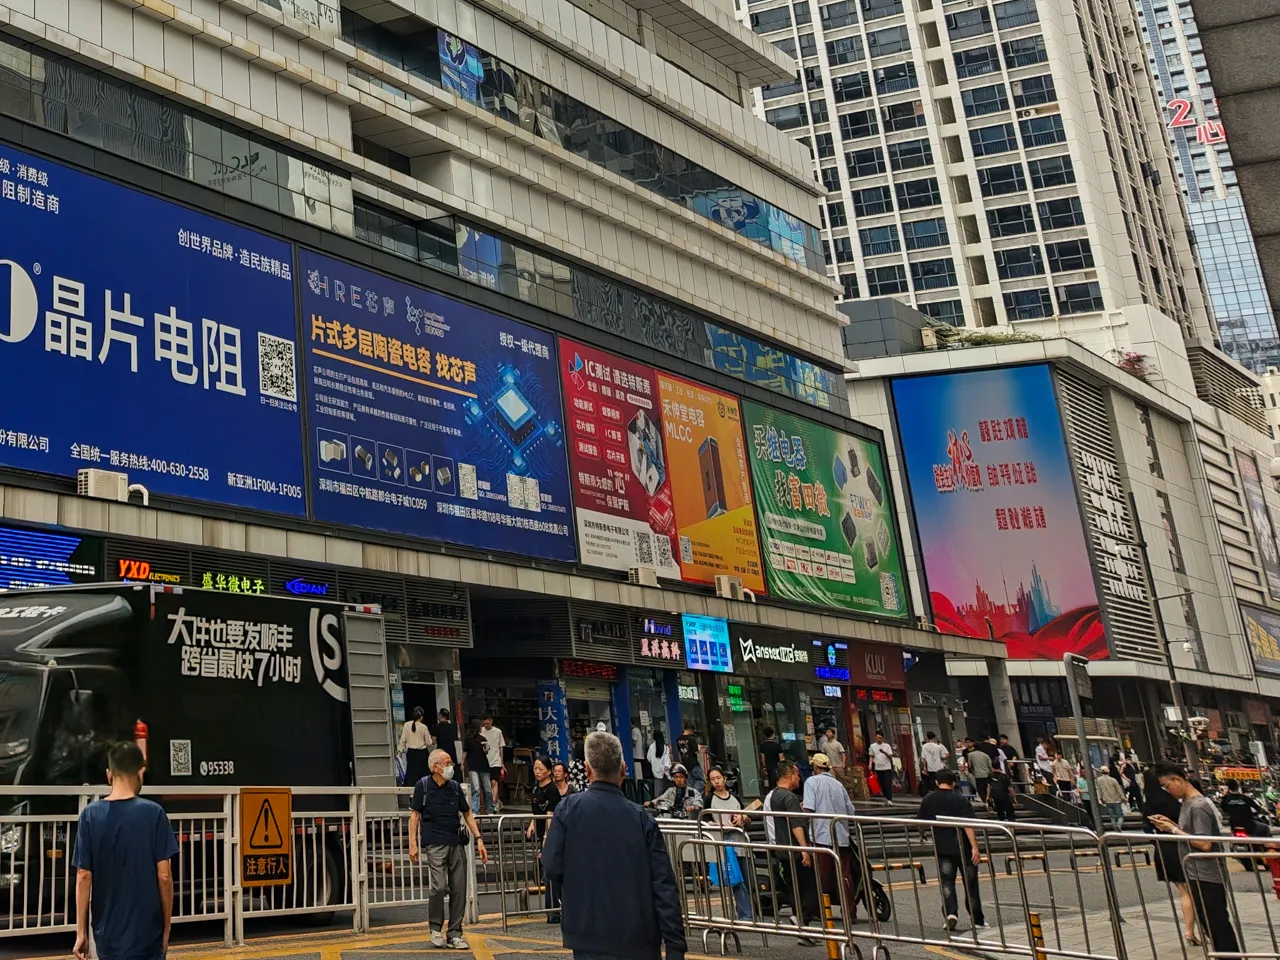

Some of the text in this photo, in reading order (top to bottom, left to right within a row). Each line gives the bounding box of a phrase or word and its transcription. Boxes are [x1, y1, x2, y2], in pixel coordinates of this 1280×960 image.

[44, 275, 247, 397] 晶片电阻
[311, 313, 477, 386] 片式多层陶瓷电容 找芯声
[499, 331, 549, 360] 授权一级代理商
[665, 421, 693, 444] MLCC
[227, 472, 302, 499] 新亚洲1F004-1F005
[119, 559, 150, 580] YXD
[167, 606, 293, 652] 大件也要发顺丰
[181, 645, 302, 687] 跨省最快7小时
[208, 760, 235, 776] 95338
[246, 857, 287, 876] 注意行人
